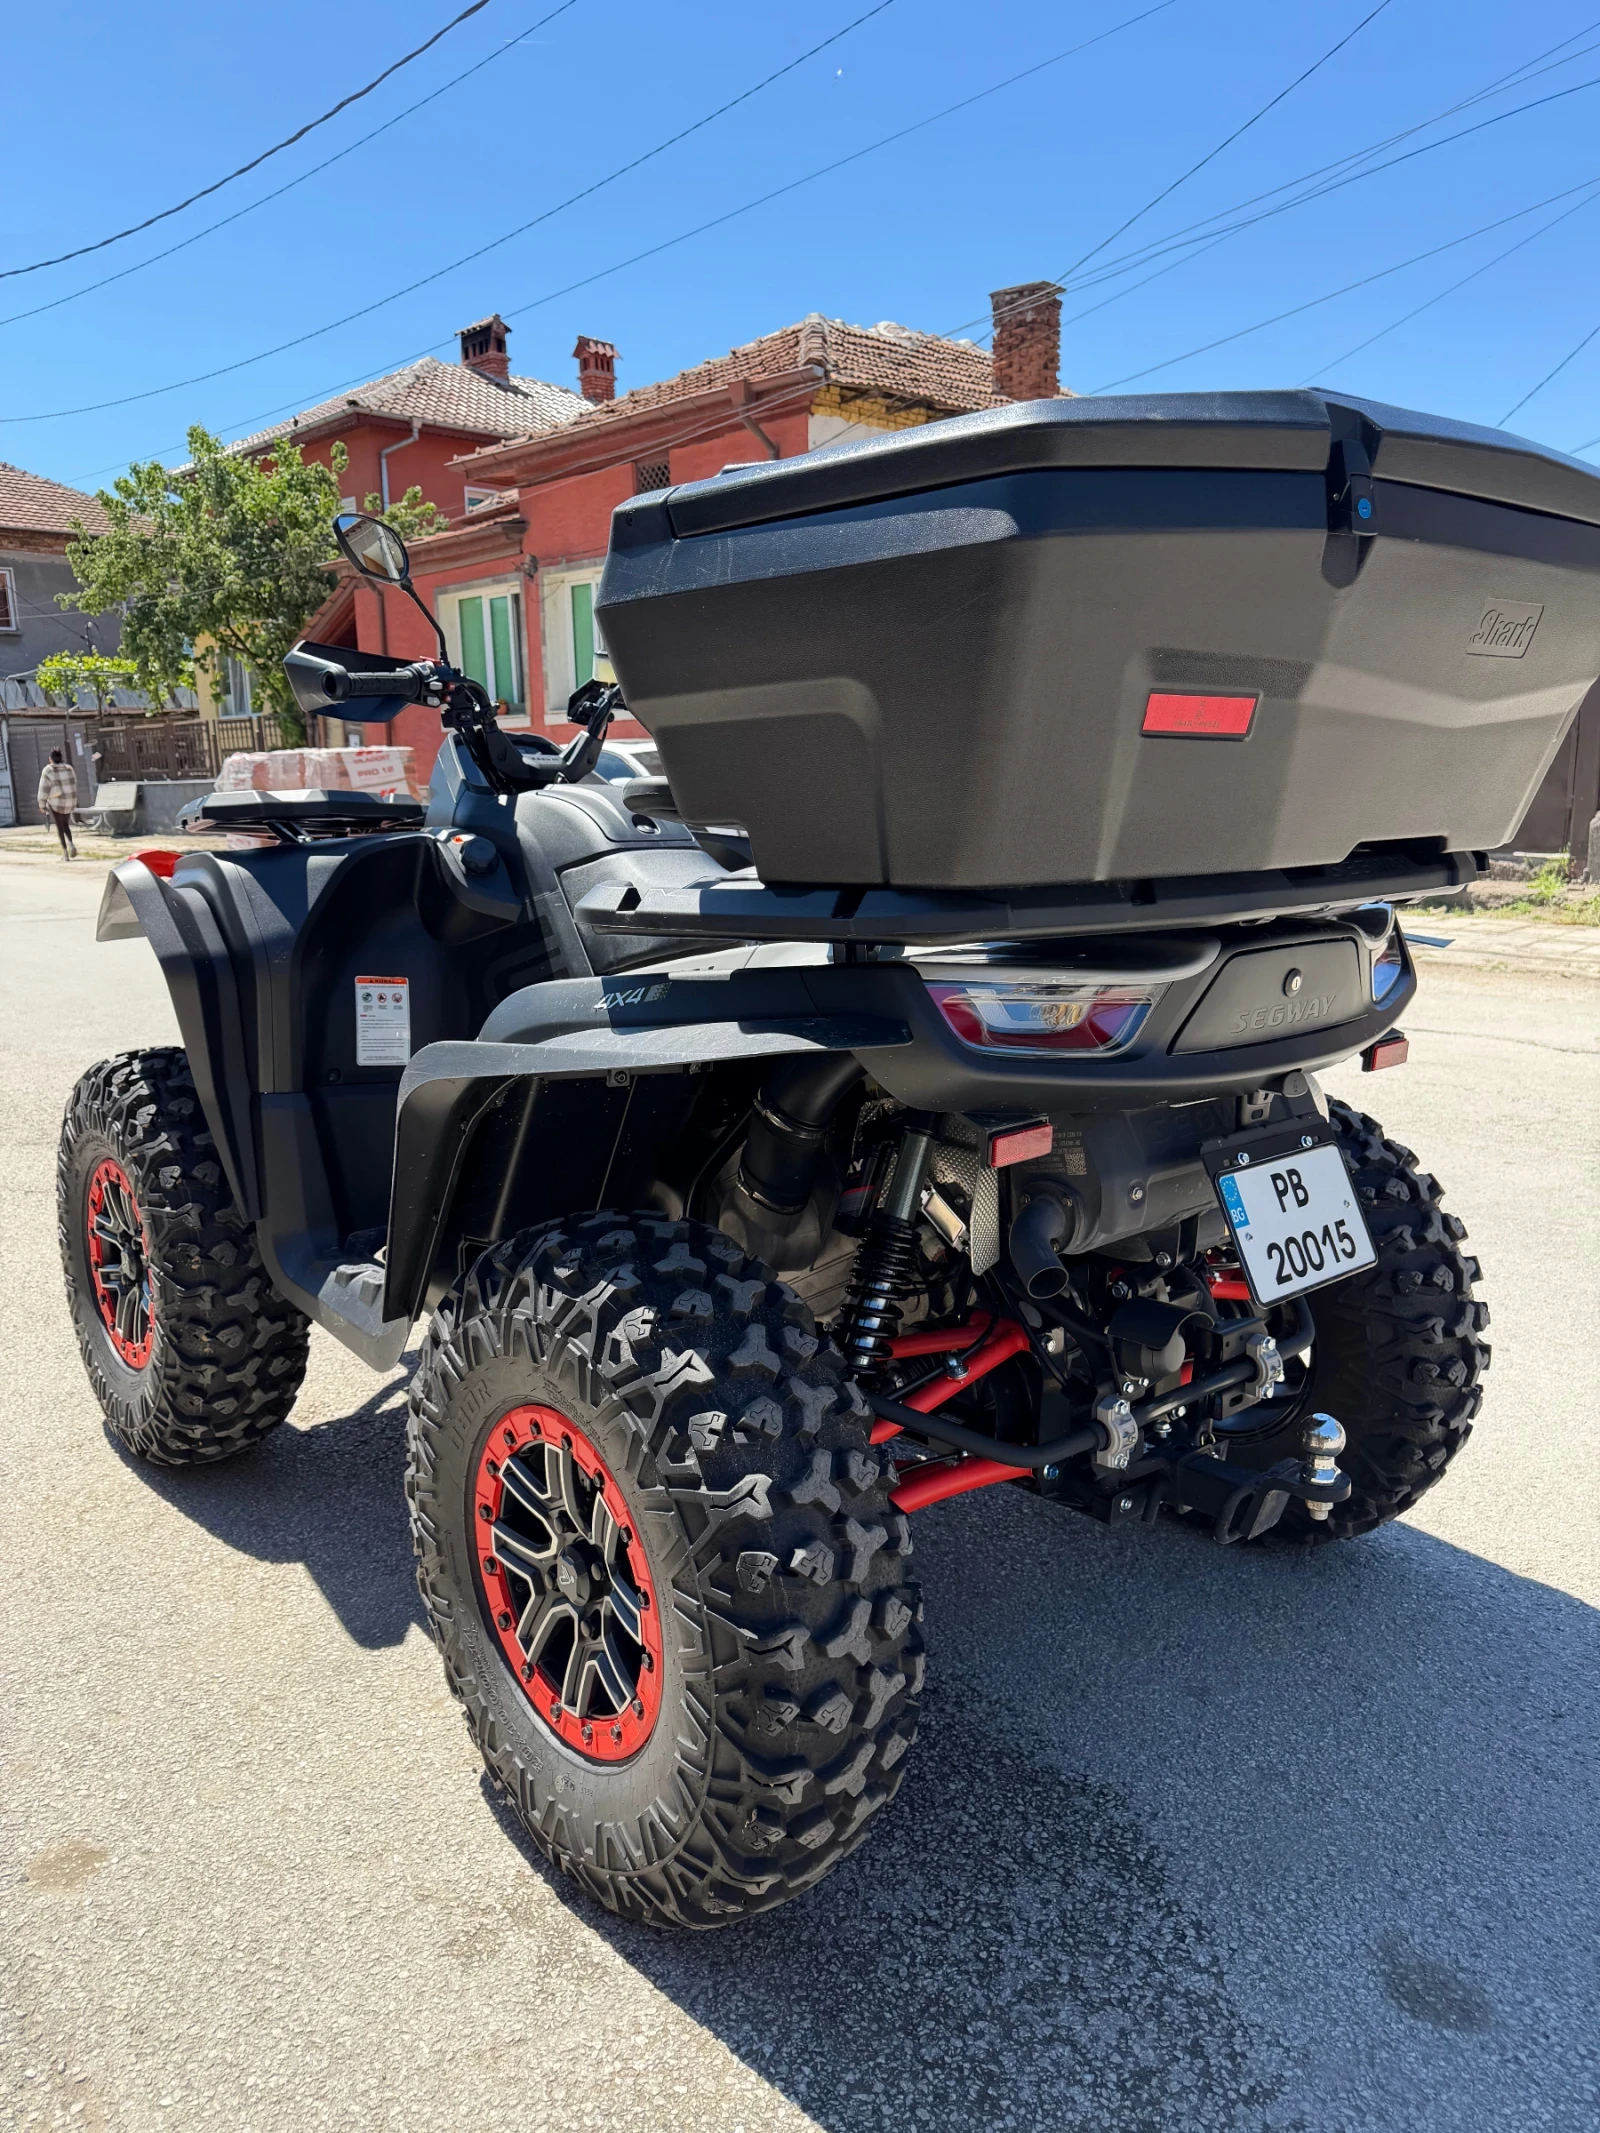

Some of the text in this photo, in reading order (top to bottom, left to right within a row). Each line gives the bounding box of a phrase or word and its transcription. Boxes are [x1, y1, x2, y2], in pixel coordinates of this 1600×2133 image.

[1229, 994, 1336, 1034] SEGWAY
[1269, 1168, 1309, 1213] PB
[1230, 1207, 1245, 1223] BG
[1266, 1218, 1356, 1286] 20015
